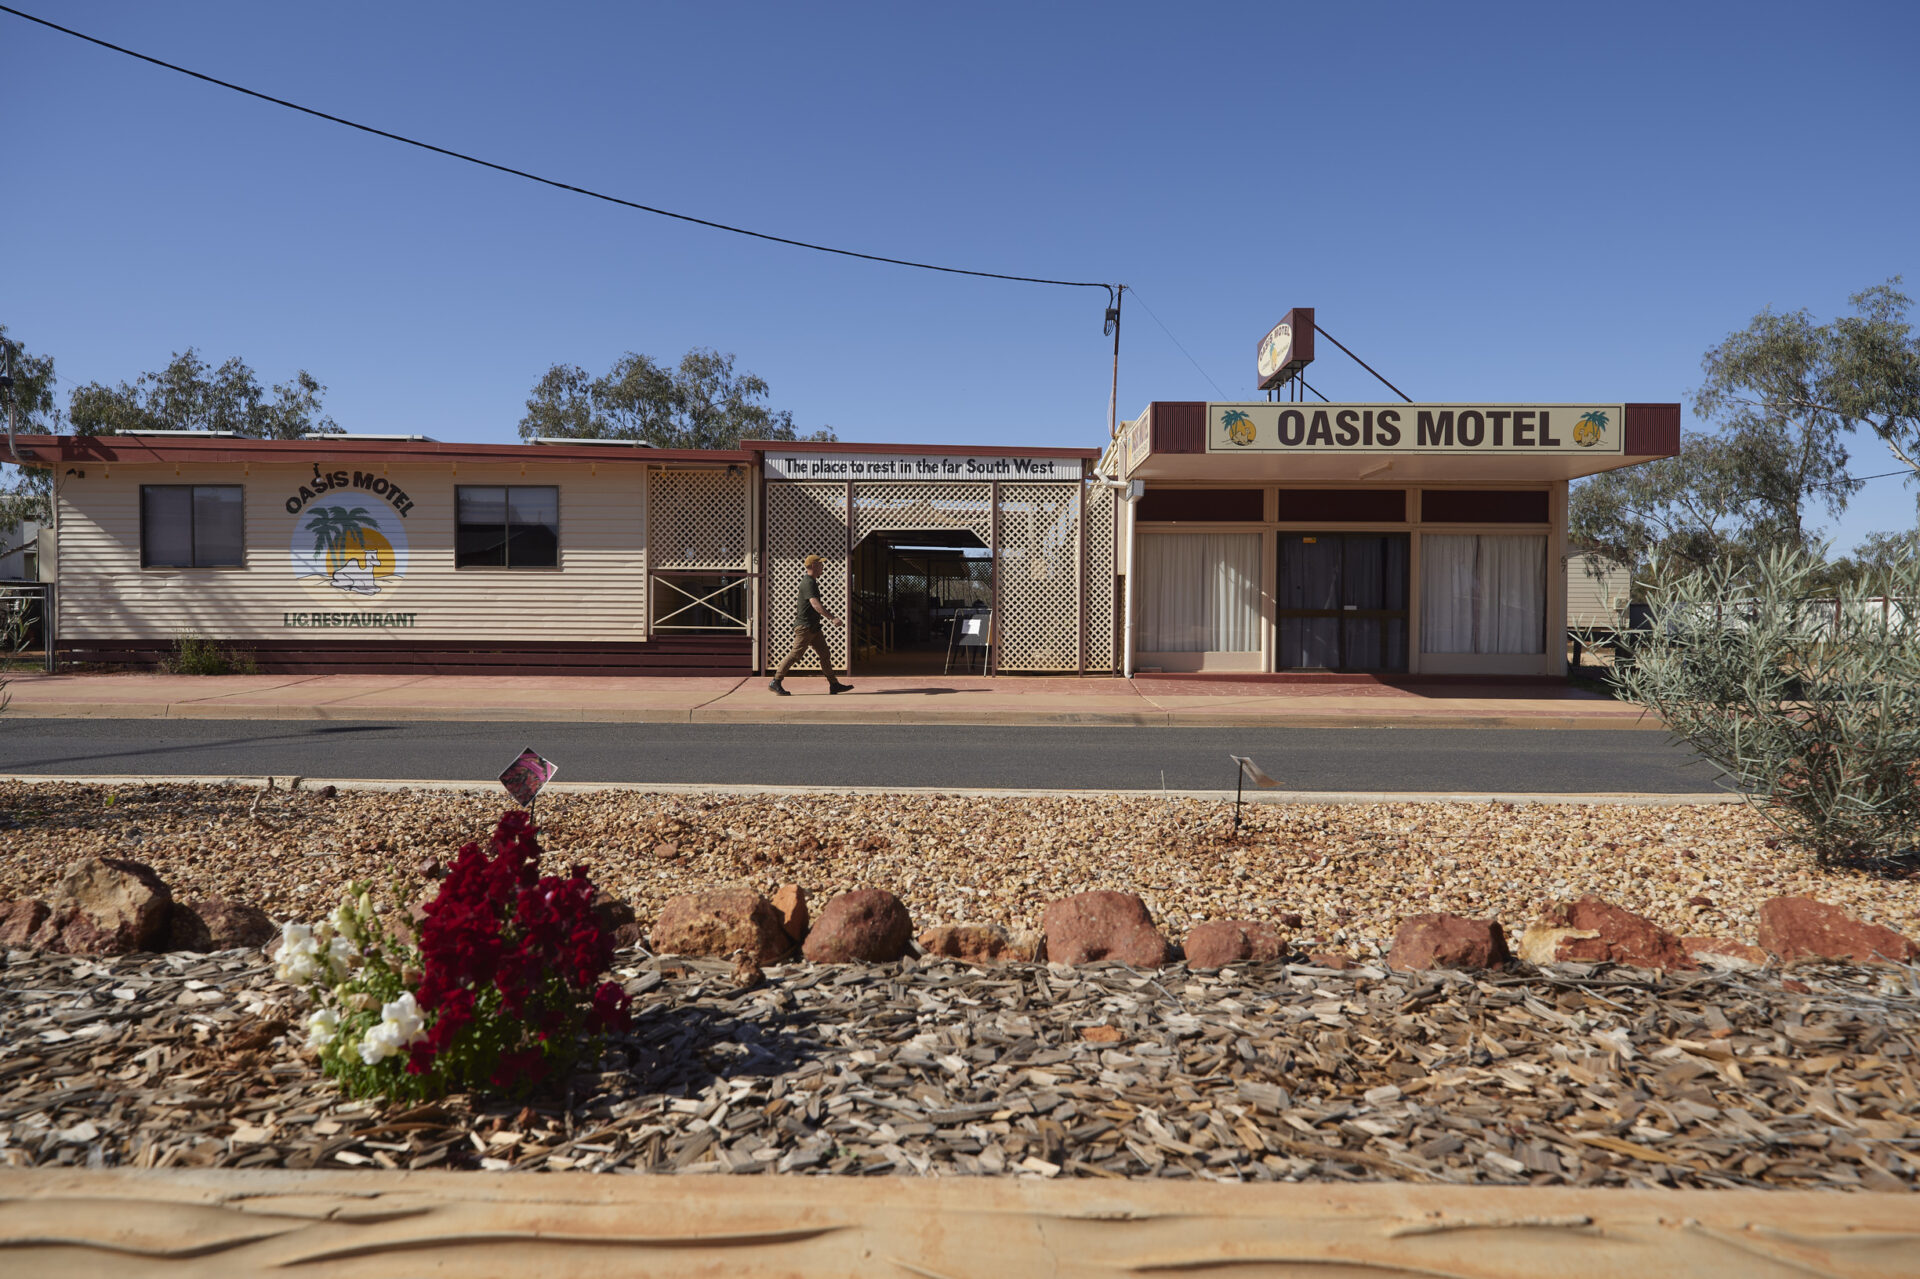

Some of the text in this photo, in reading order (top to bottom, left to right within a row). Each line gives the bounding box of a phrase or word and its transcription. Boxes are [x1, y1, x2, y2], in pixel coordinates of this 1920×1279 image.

[1277, 409, 1560, 446] OASIS MOTEL
[785, 458, 1054, 476] The place to rest in the far South West
[285, 471, 415, 518] OASIS MOTEL
[311, 612, 417, 627] RESTAURANT
